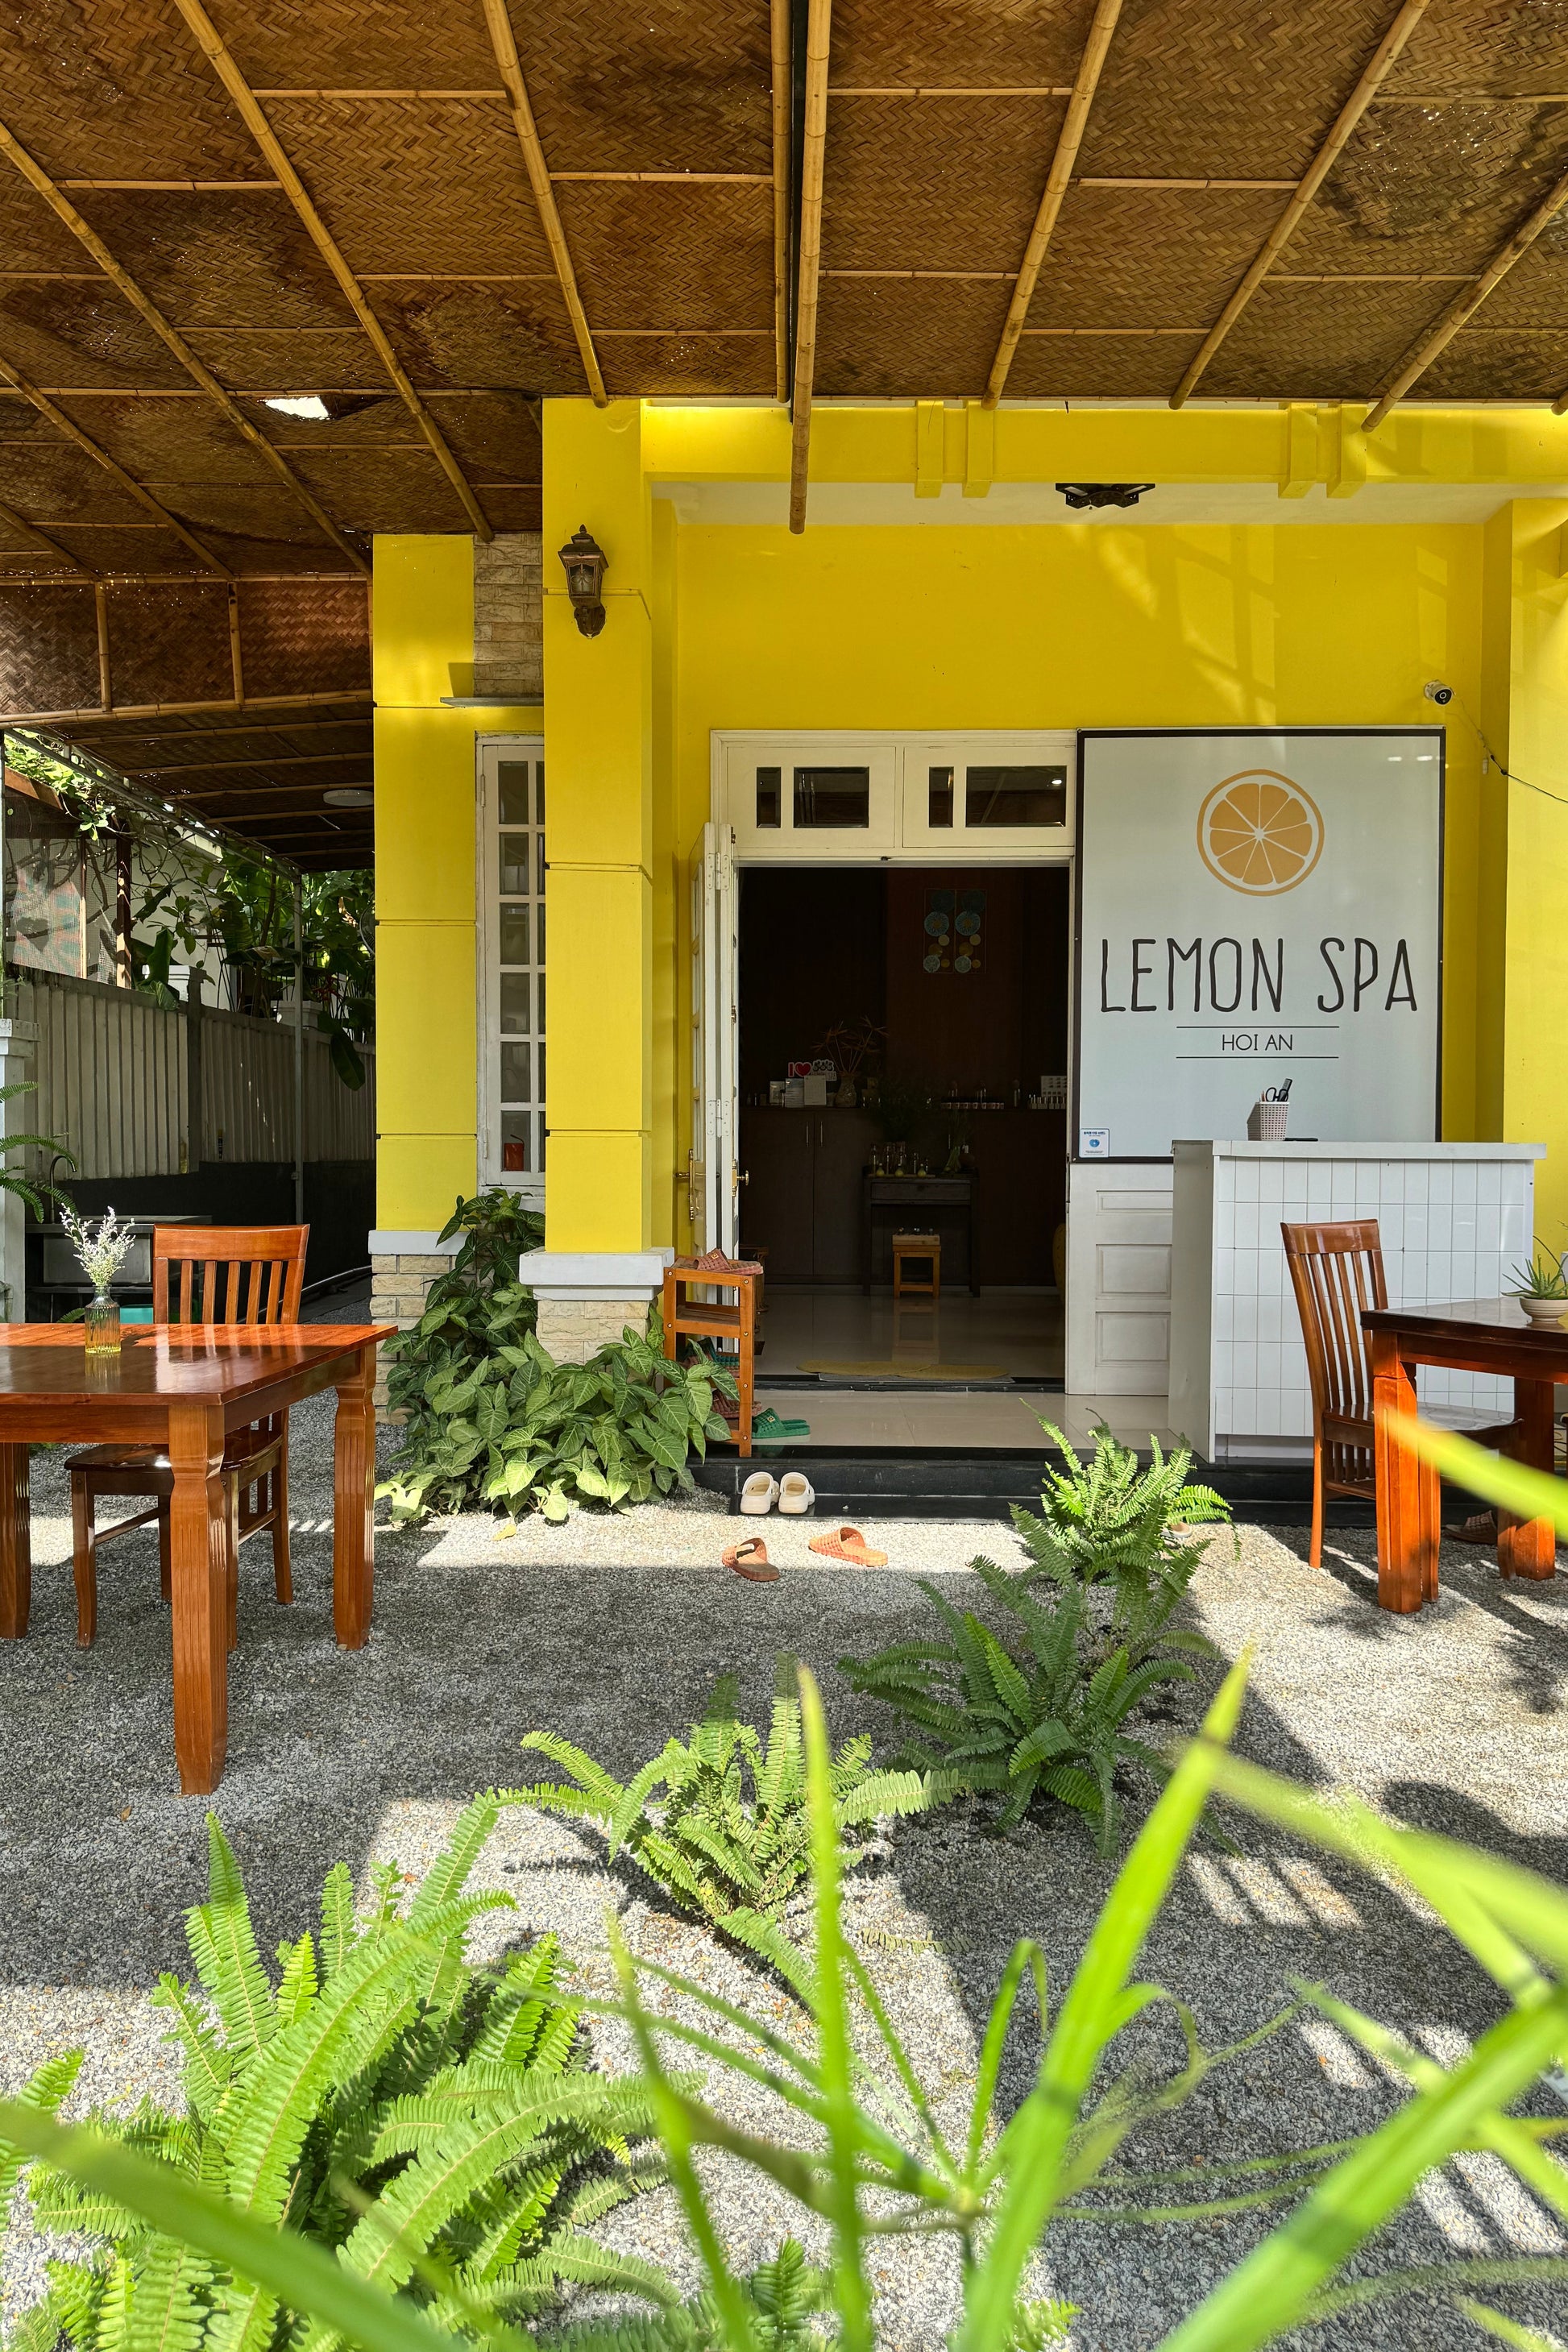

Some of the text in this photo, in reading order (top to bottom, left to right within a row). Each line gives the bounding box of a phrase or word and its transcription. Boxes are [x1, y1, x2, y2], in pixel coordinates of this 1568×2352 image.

[1101, 937, 1418, 1014] LEMON SPA
[1222, 1034, 1294, 1052] HOI AN
